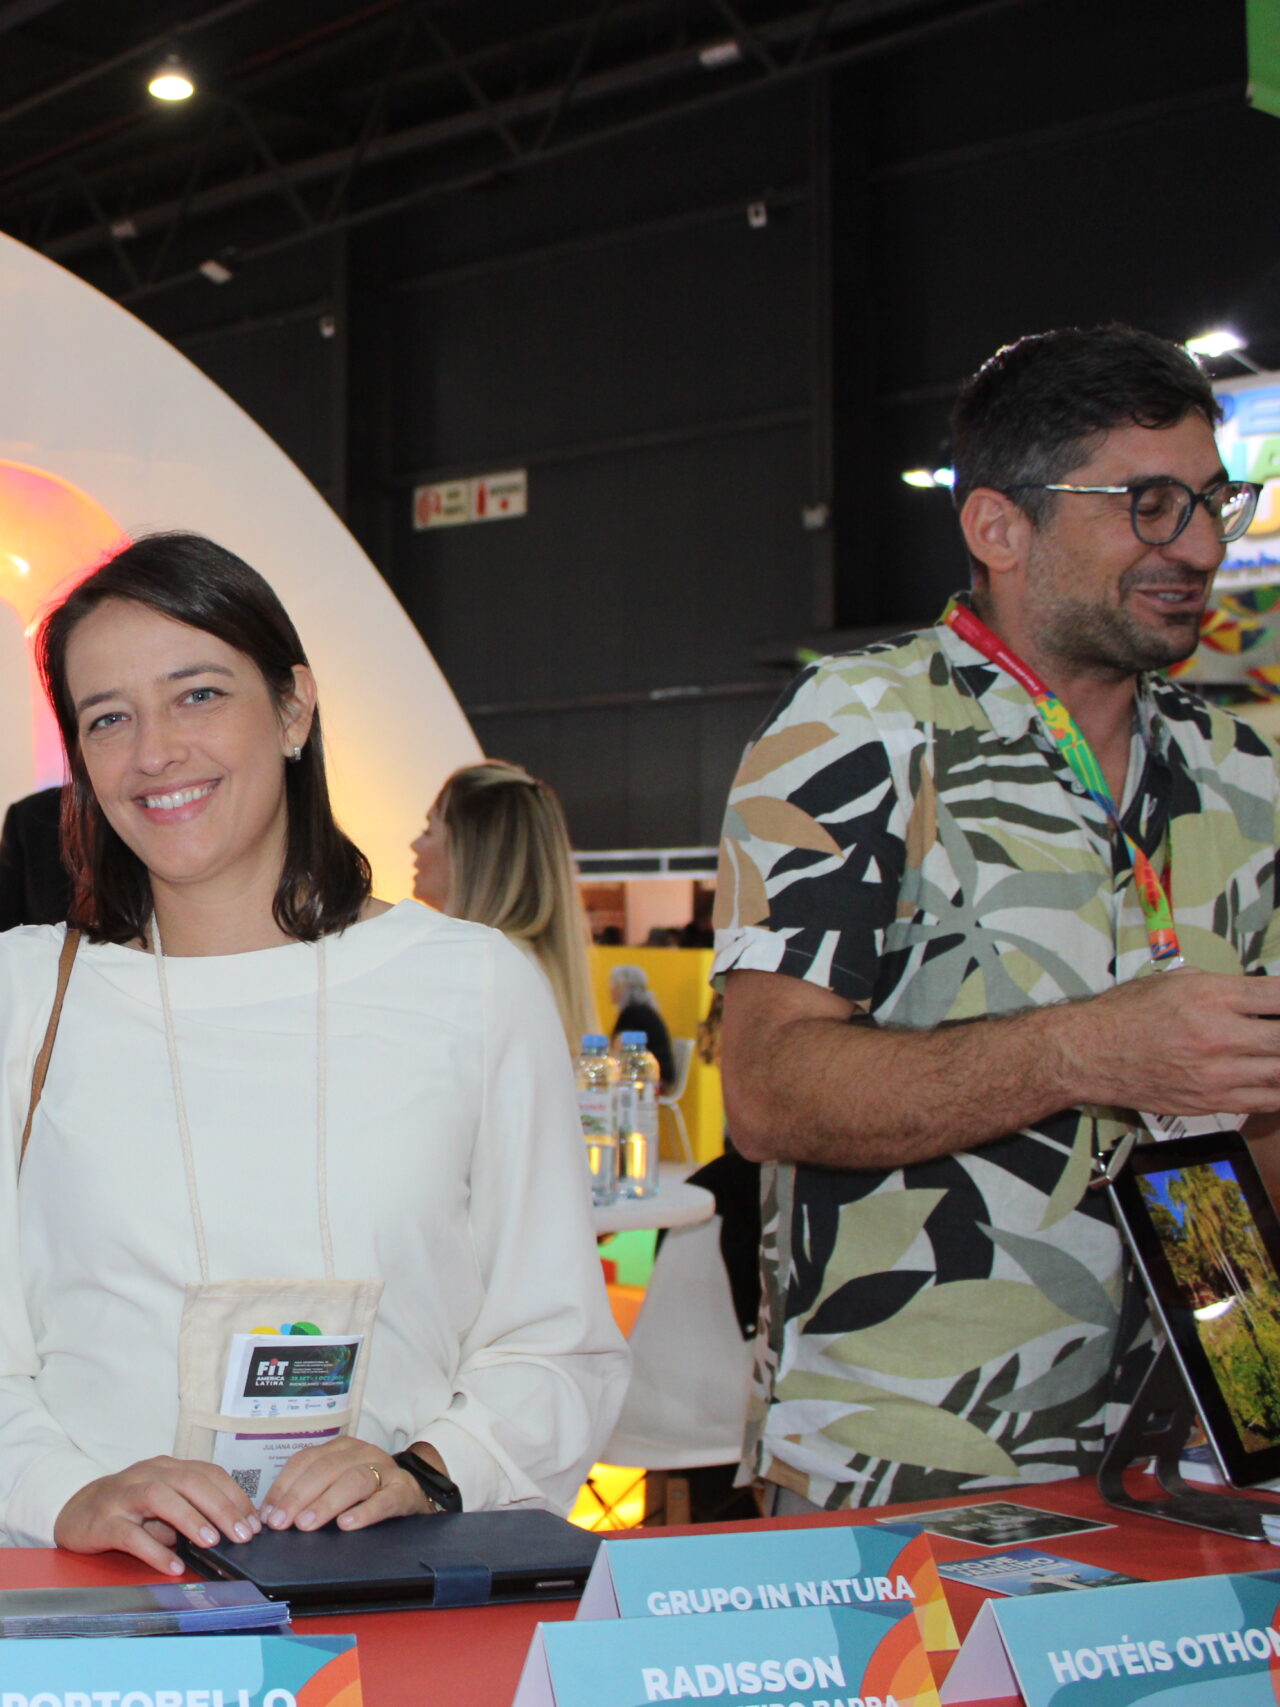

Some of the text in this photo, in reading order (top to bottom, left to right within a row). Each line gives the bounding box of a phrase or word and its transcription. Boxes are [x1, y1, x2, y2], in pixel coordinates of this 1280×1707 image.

[263, 1442, 291, 1451] JULIANA
[647, 1575, 917, 1617] GRUPO IN NATURA
[641, 1655, 846, 1701] RADISSON
[1047, 1634, 1174, 1684] HOTÉIS
